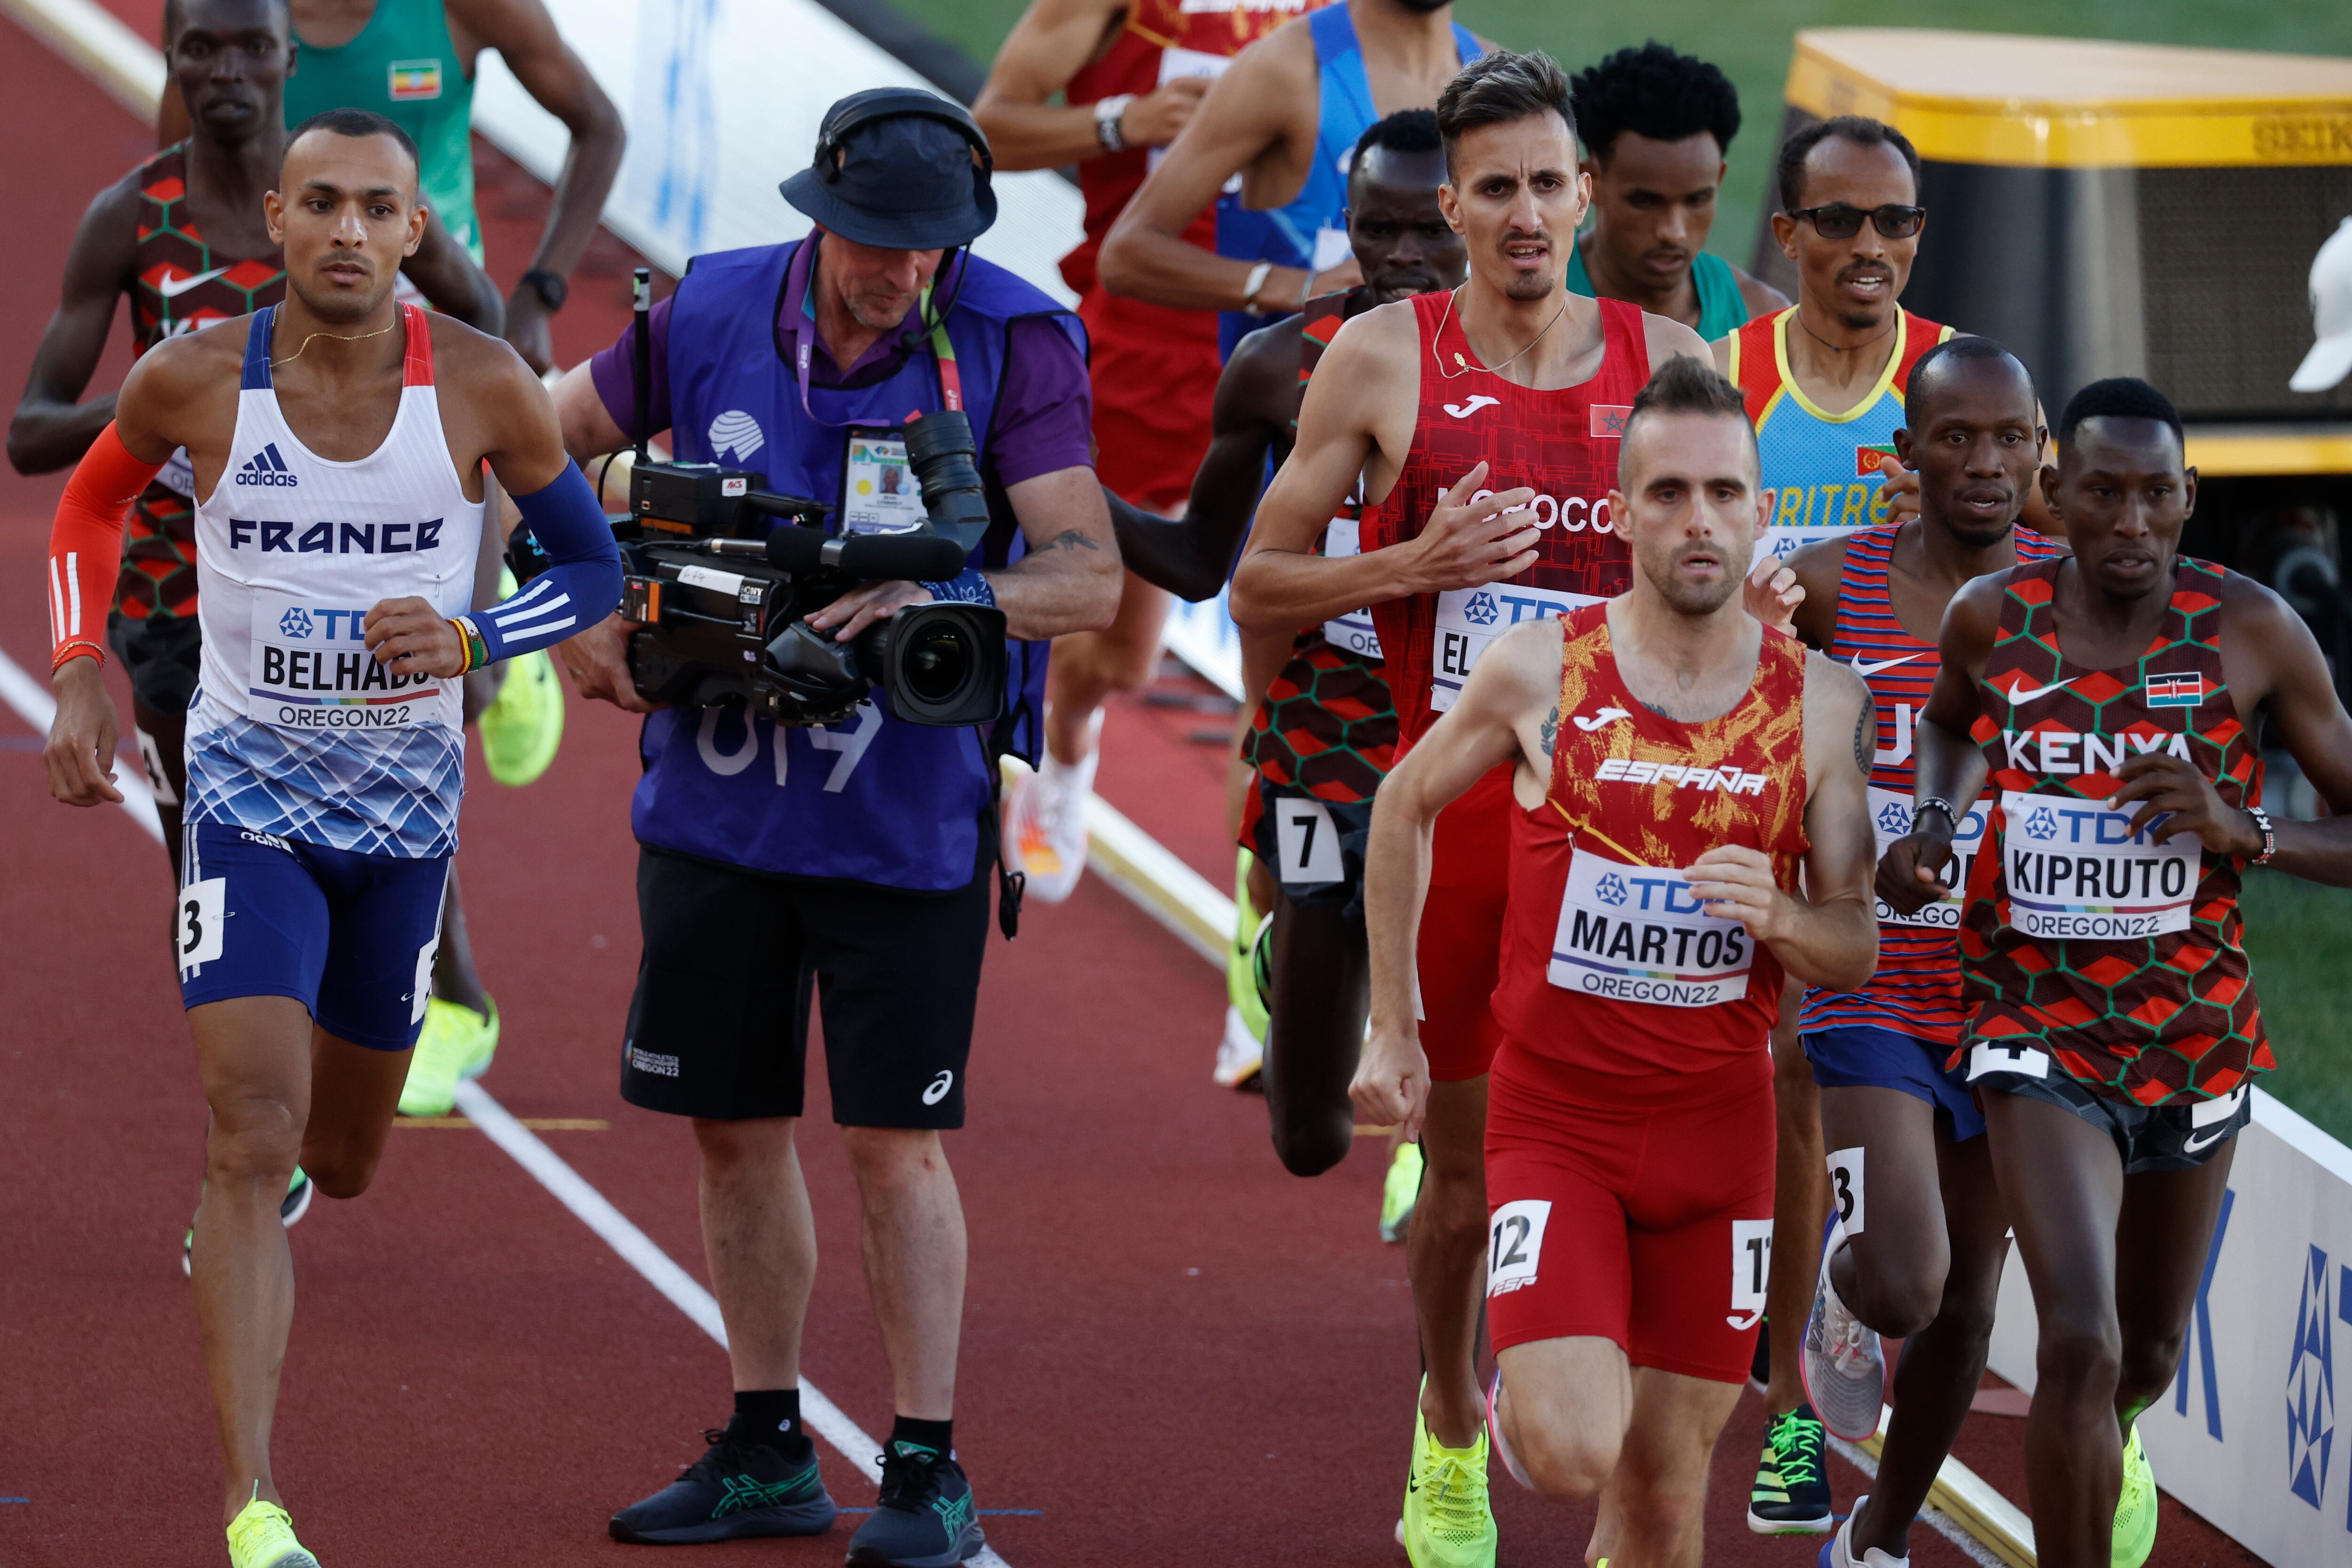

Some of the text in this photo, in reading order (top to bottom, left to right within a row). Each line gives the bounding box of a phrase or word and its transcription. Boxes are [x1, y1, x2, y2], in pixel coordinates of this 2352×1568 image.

[236, 470, 297, 487] adidas
[230, 517, 444, 554] FRANCE
[1443, 632, 1470, 677] EL
[279, 706, 410, 727] OREGON22
[1594, 758, 1768, 796] ESPAÑA
[1293, 816, 1318, 868] 7
[2014, 849, 2186, 898] KIPRUTO
[183, 899, 202, 954] 3
[1571, 909, 1744, 969] MARTOS
[2027, 914, 2160, 936] OREGON22
[1583, 973, 1719, 1003] OREGON22
[1493, 1215, 1531, 1275] 12
[1746, 1237, 1771, 1294] 1
